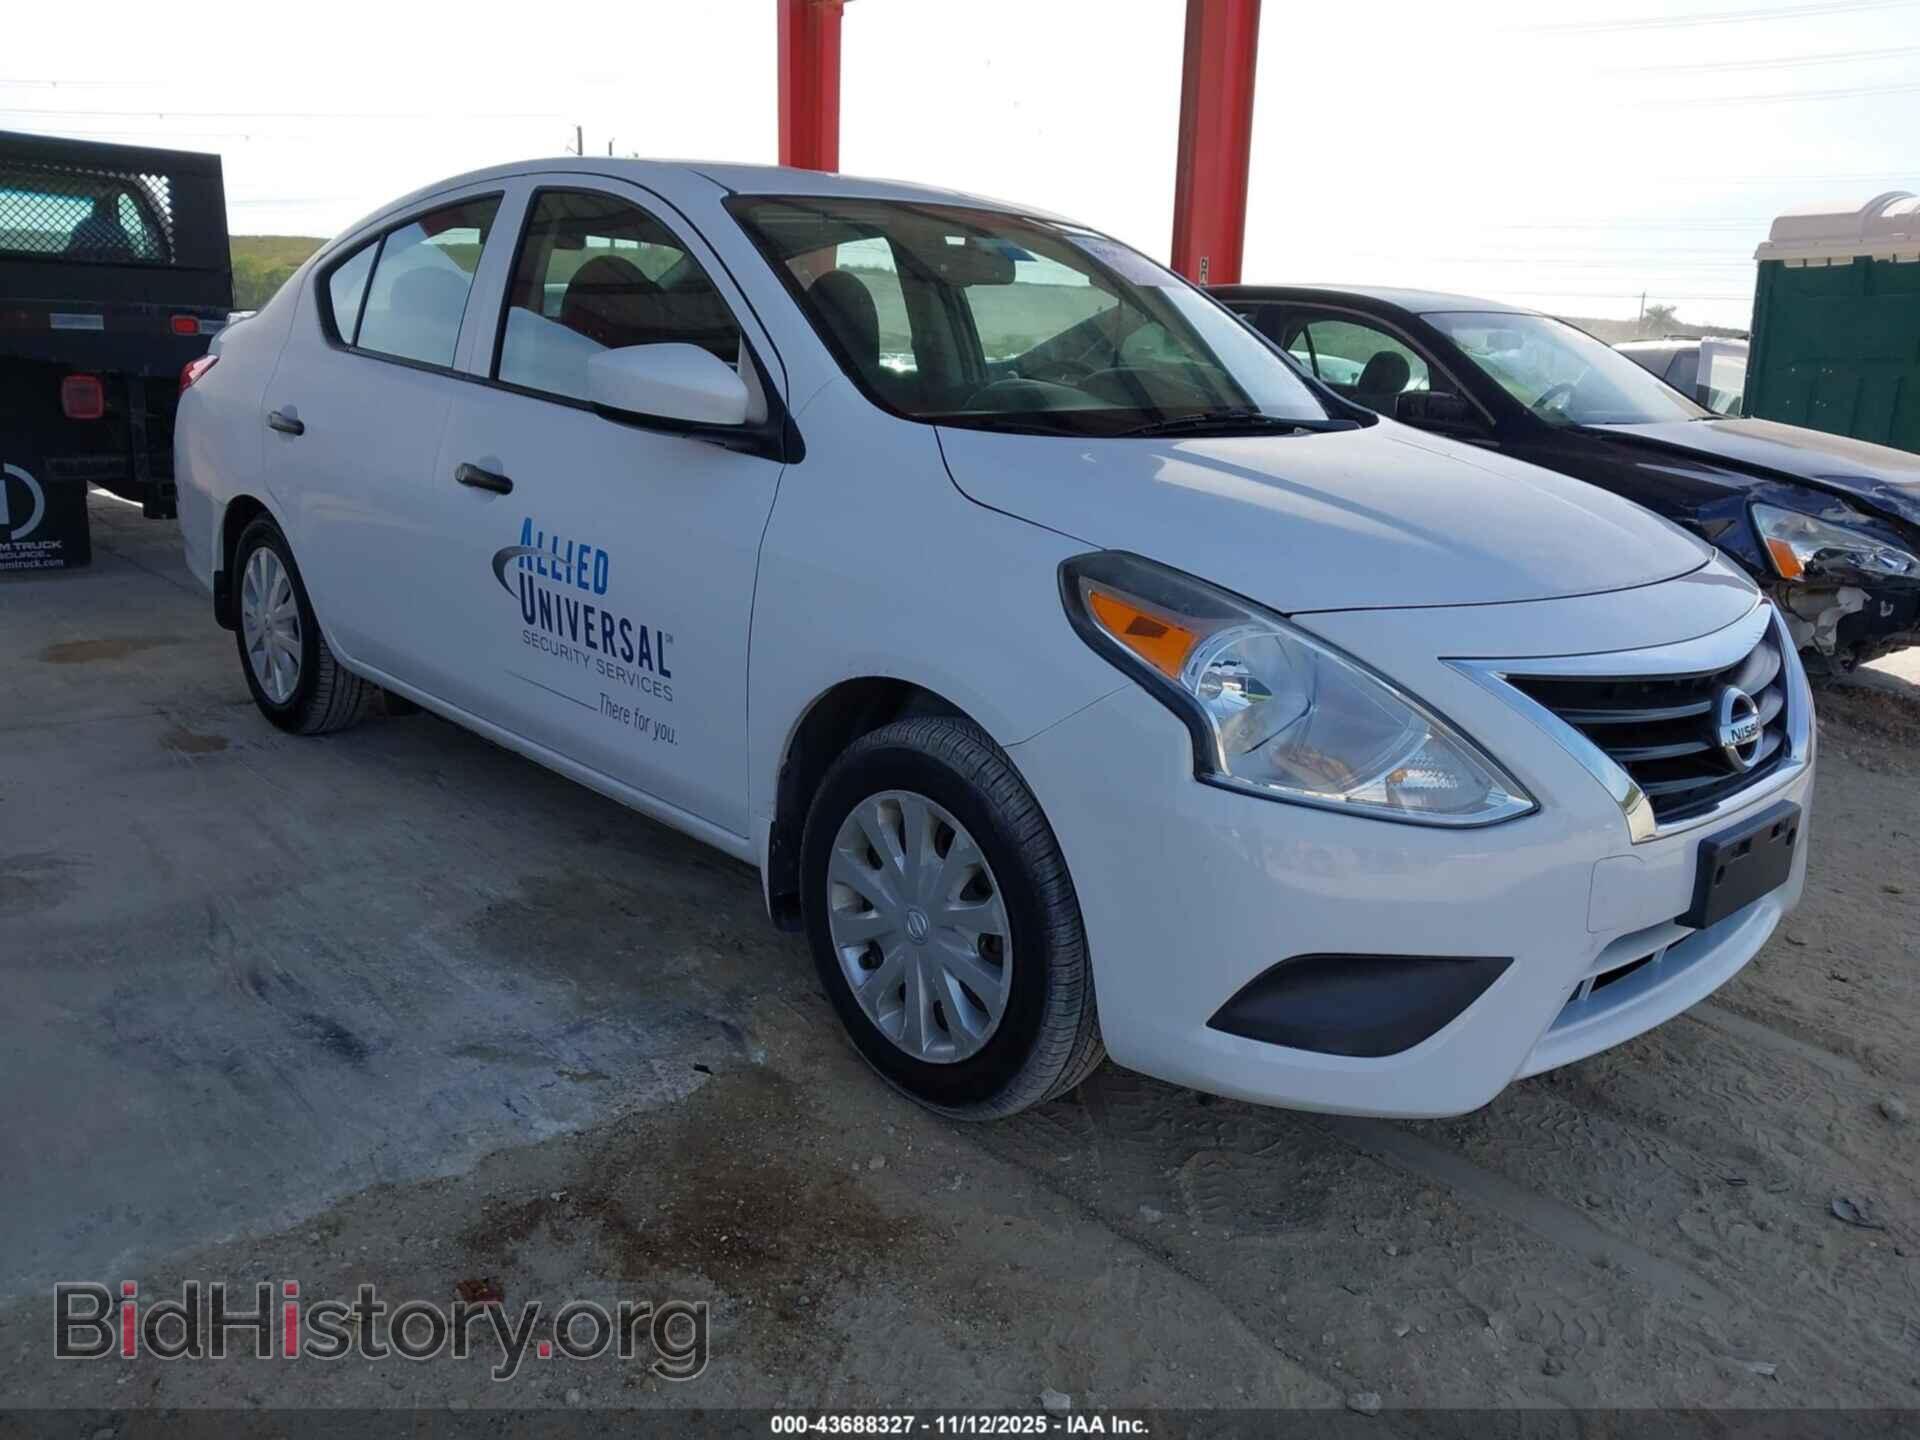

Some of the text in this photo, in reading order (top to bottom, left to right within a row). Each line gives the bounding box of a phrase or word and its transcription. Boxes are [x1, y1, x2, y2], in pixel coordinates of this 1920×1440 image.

[12, 540, 64, 550] TRUCK
[519, 517, 609, 596] ALLIED
[519, 572, 672, 679] UNIVERSAL
[522, 629, 673, 702] SECURITY SERVICES
[600, 692, 630, 725] There
[633, 707, 651, 733] for
